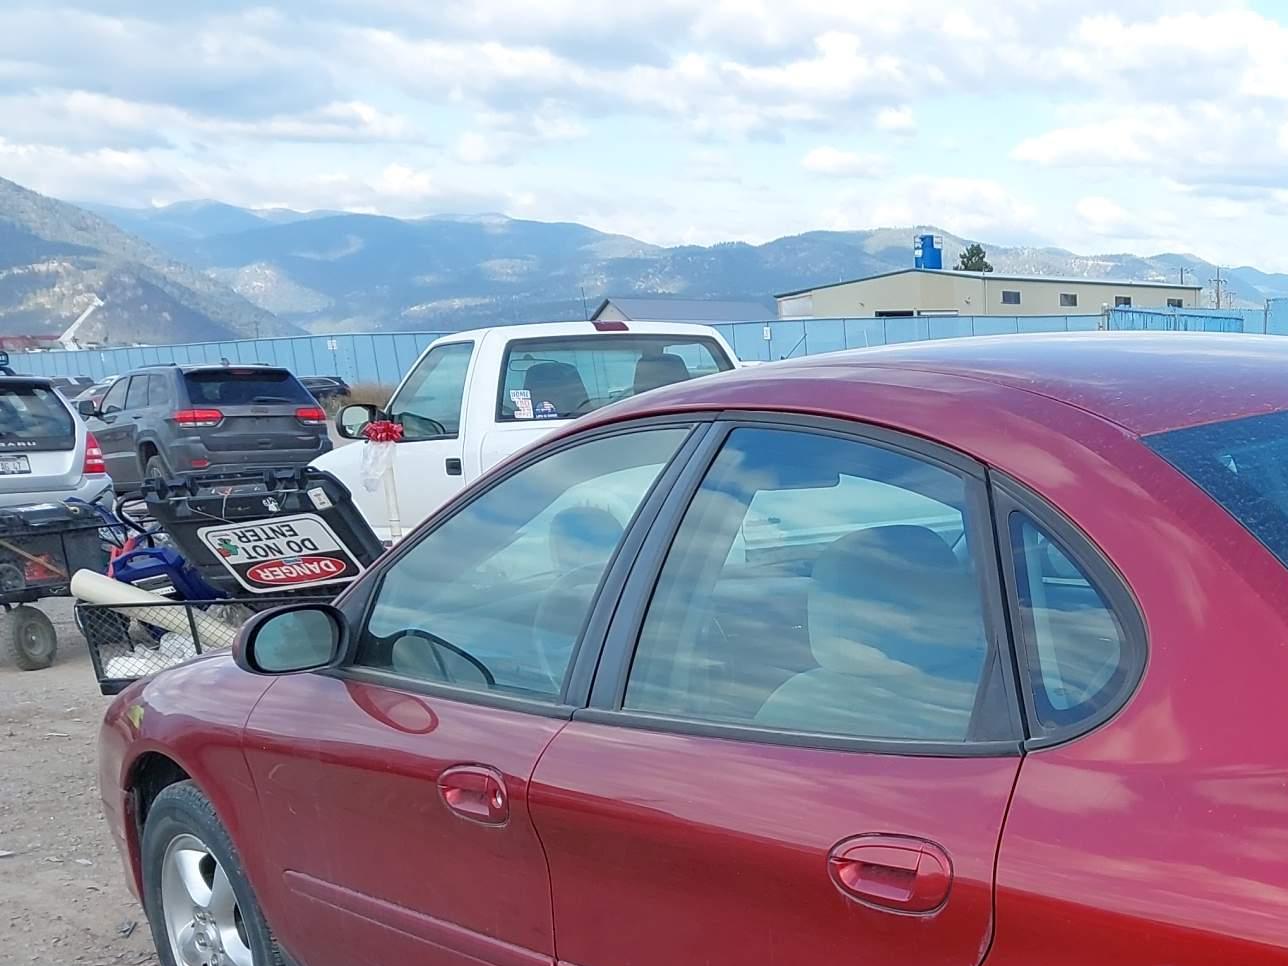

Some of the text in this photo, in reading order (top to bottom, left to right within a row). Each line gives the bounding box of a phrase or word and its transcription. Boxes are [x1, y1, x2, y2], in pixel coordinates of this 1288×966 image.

[232, 524, 299, 543] ENTER
[242, 538, 319, 559] DO NOT
[256, 560, 337, 580] DANGER
